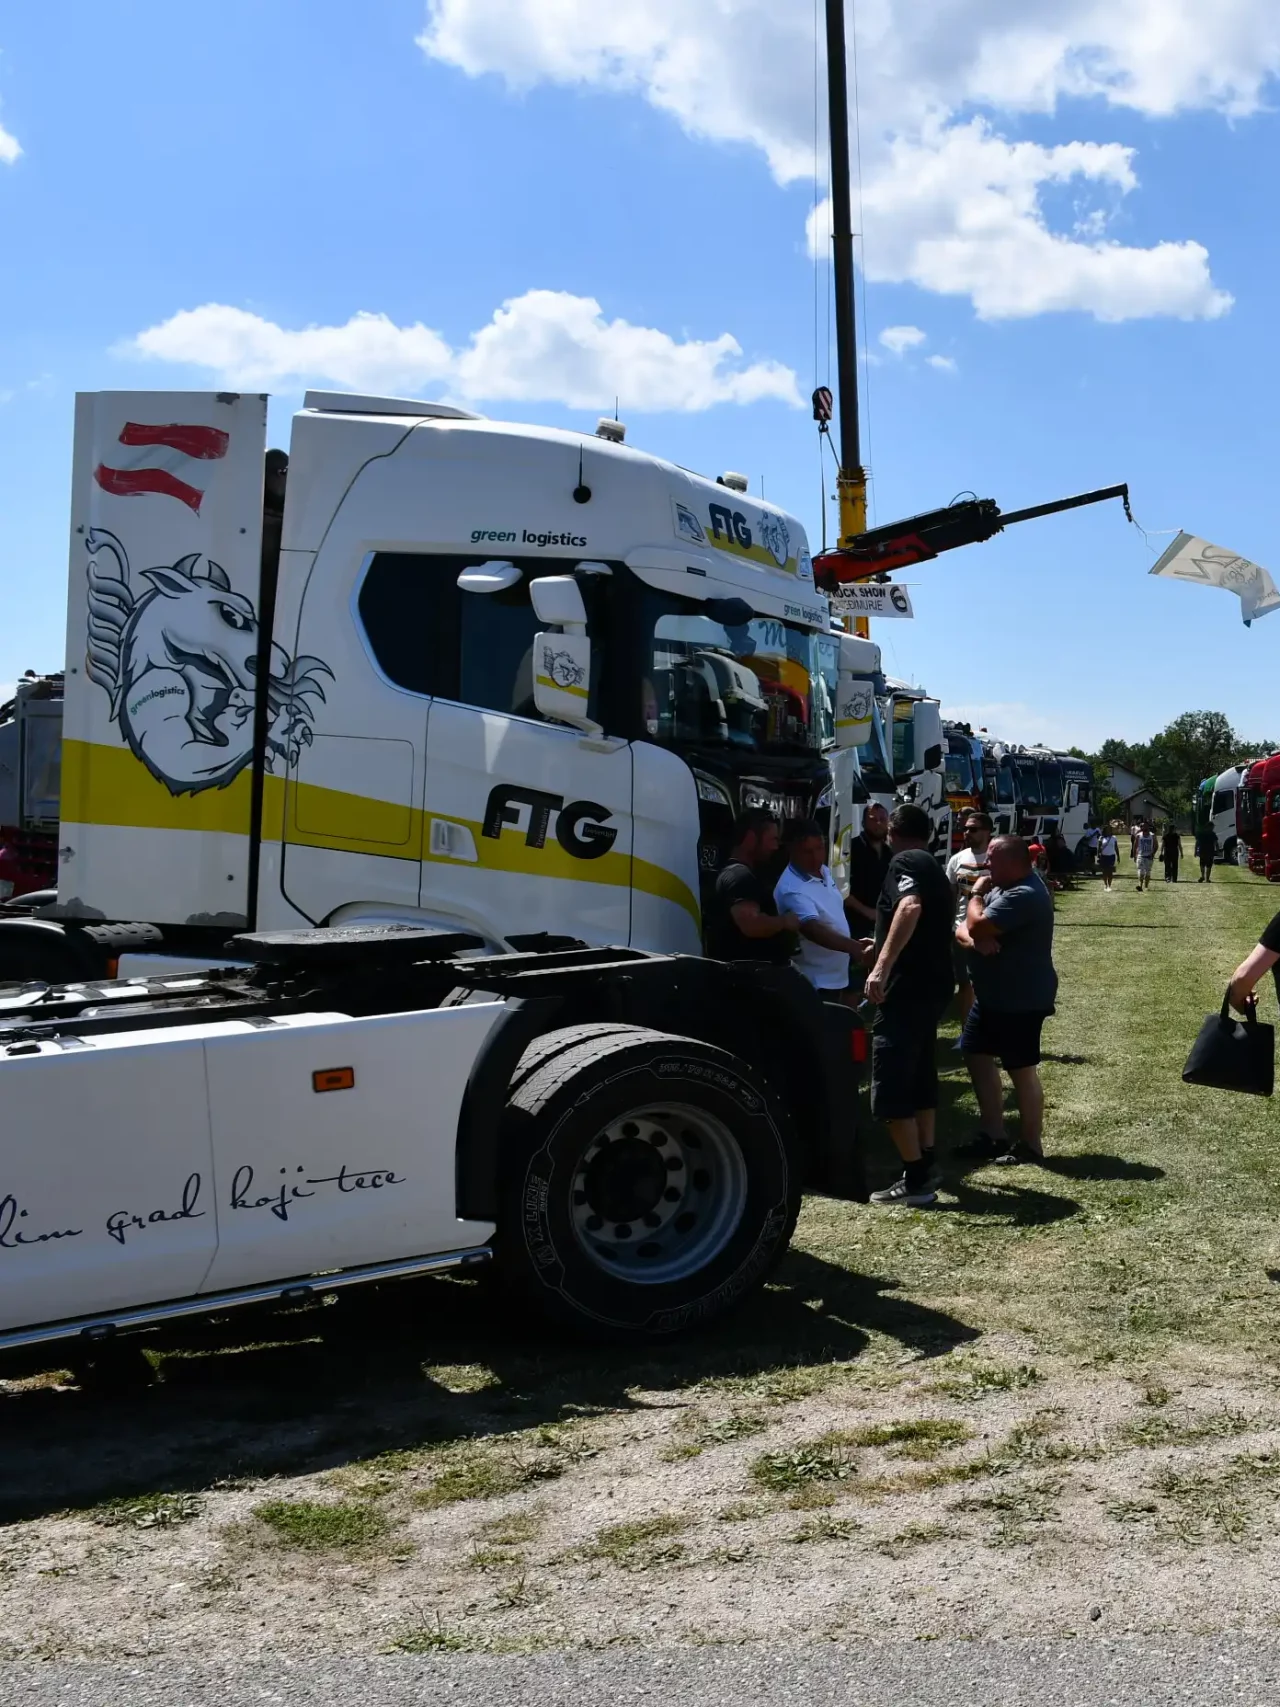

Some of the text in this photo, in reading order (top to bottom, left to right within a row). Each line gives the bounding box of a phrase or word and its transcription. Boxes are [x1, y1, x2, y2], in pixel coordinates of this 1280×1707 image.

[470, 529, 587, 547] green logistics
[708, 502, 751, 549] FTG
[832, 587, 886, 598] RUCK SHOW
[784, 604, 801, 616] green
[802, 607, 823, 624] logistics
[131, 685, 185, 716] greenlogistics
[482, 783, 618, 860] FTG
[106, 1173, 206, 1244] grad
[229, 1165, 316, 1221] koji
